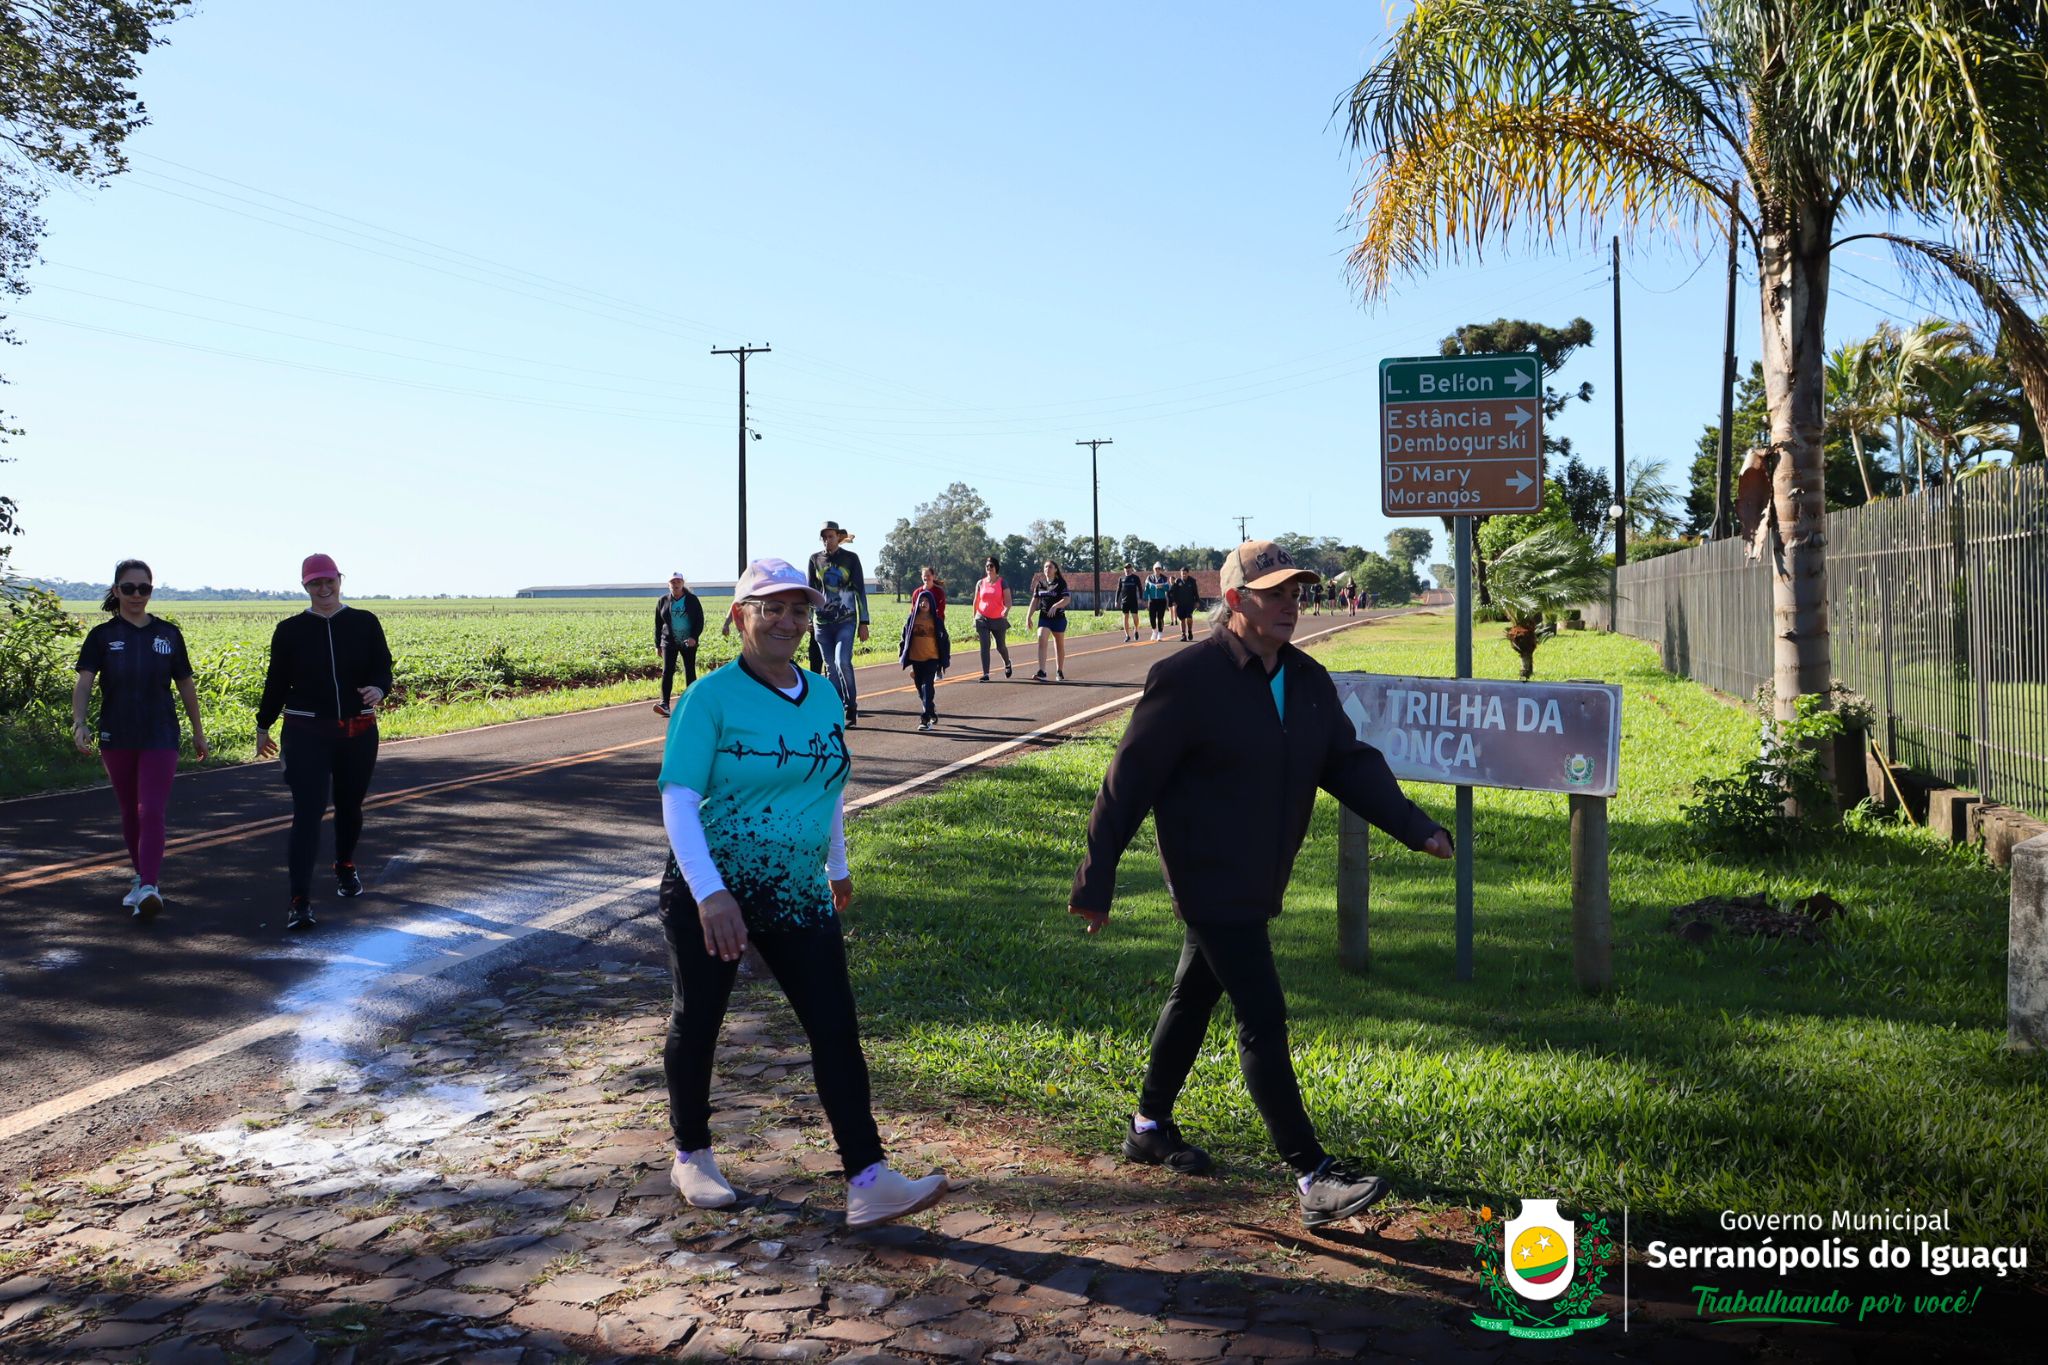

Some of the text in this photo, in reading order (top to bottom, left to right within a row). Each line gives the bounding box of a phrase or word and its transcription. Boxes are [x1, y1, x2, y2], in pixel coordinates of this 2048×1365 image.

[1387, 375, 1410, 394] L.
[1387, 408, 1492, 429] Estância
[1387, 430, 1526, 456] Dembogurski
[1388, 466, 1471, 486] D'Mary
[1389, 488, 1480, 508] Morangos
[1386, 689, 1564, 735] TRILHA DA
[1384, 727, 1477, 777] ONÇA
